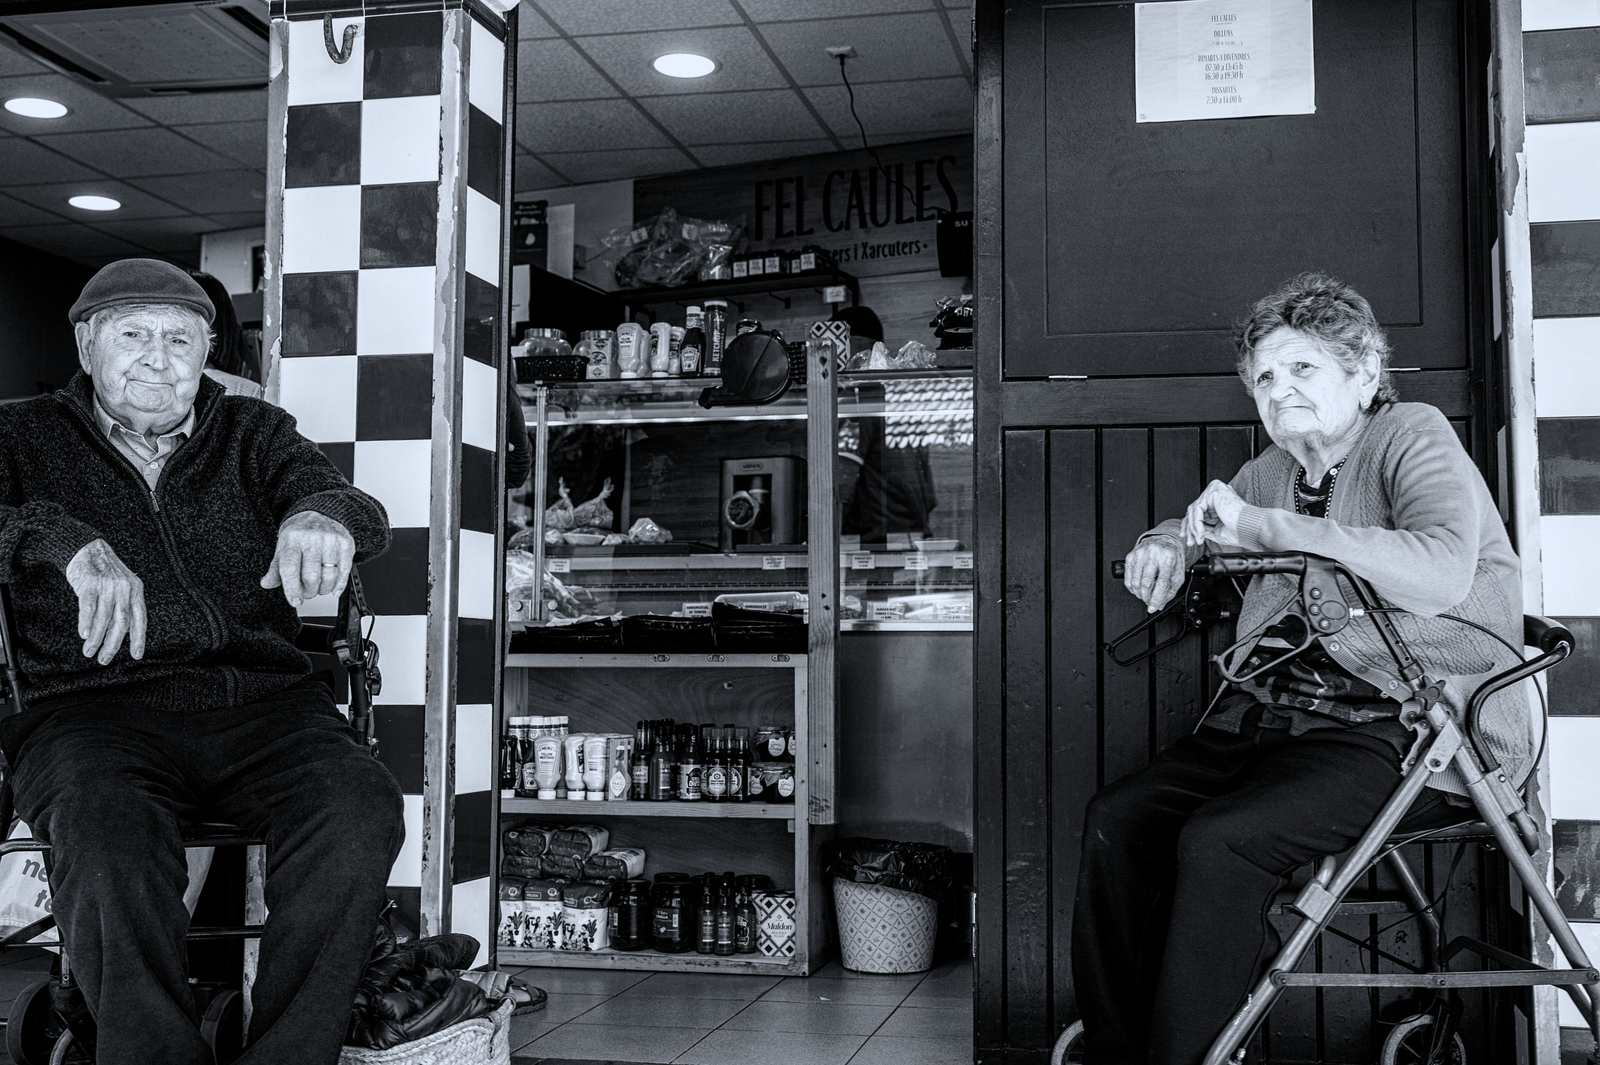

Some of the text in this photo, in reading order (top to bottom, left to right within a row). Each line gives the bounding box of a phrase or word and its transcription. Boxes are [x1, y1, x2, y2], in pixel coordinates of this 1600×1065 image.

[754, 155, 958, 241] FEL CAULES
[832, 247, 850, 264] ers
[766, 921, 793, 931] Maldon
